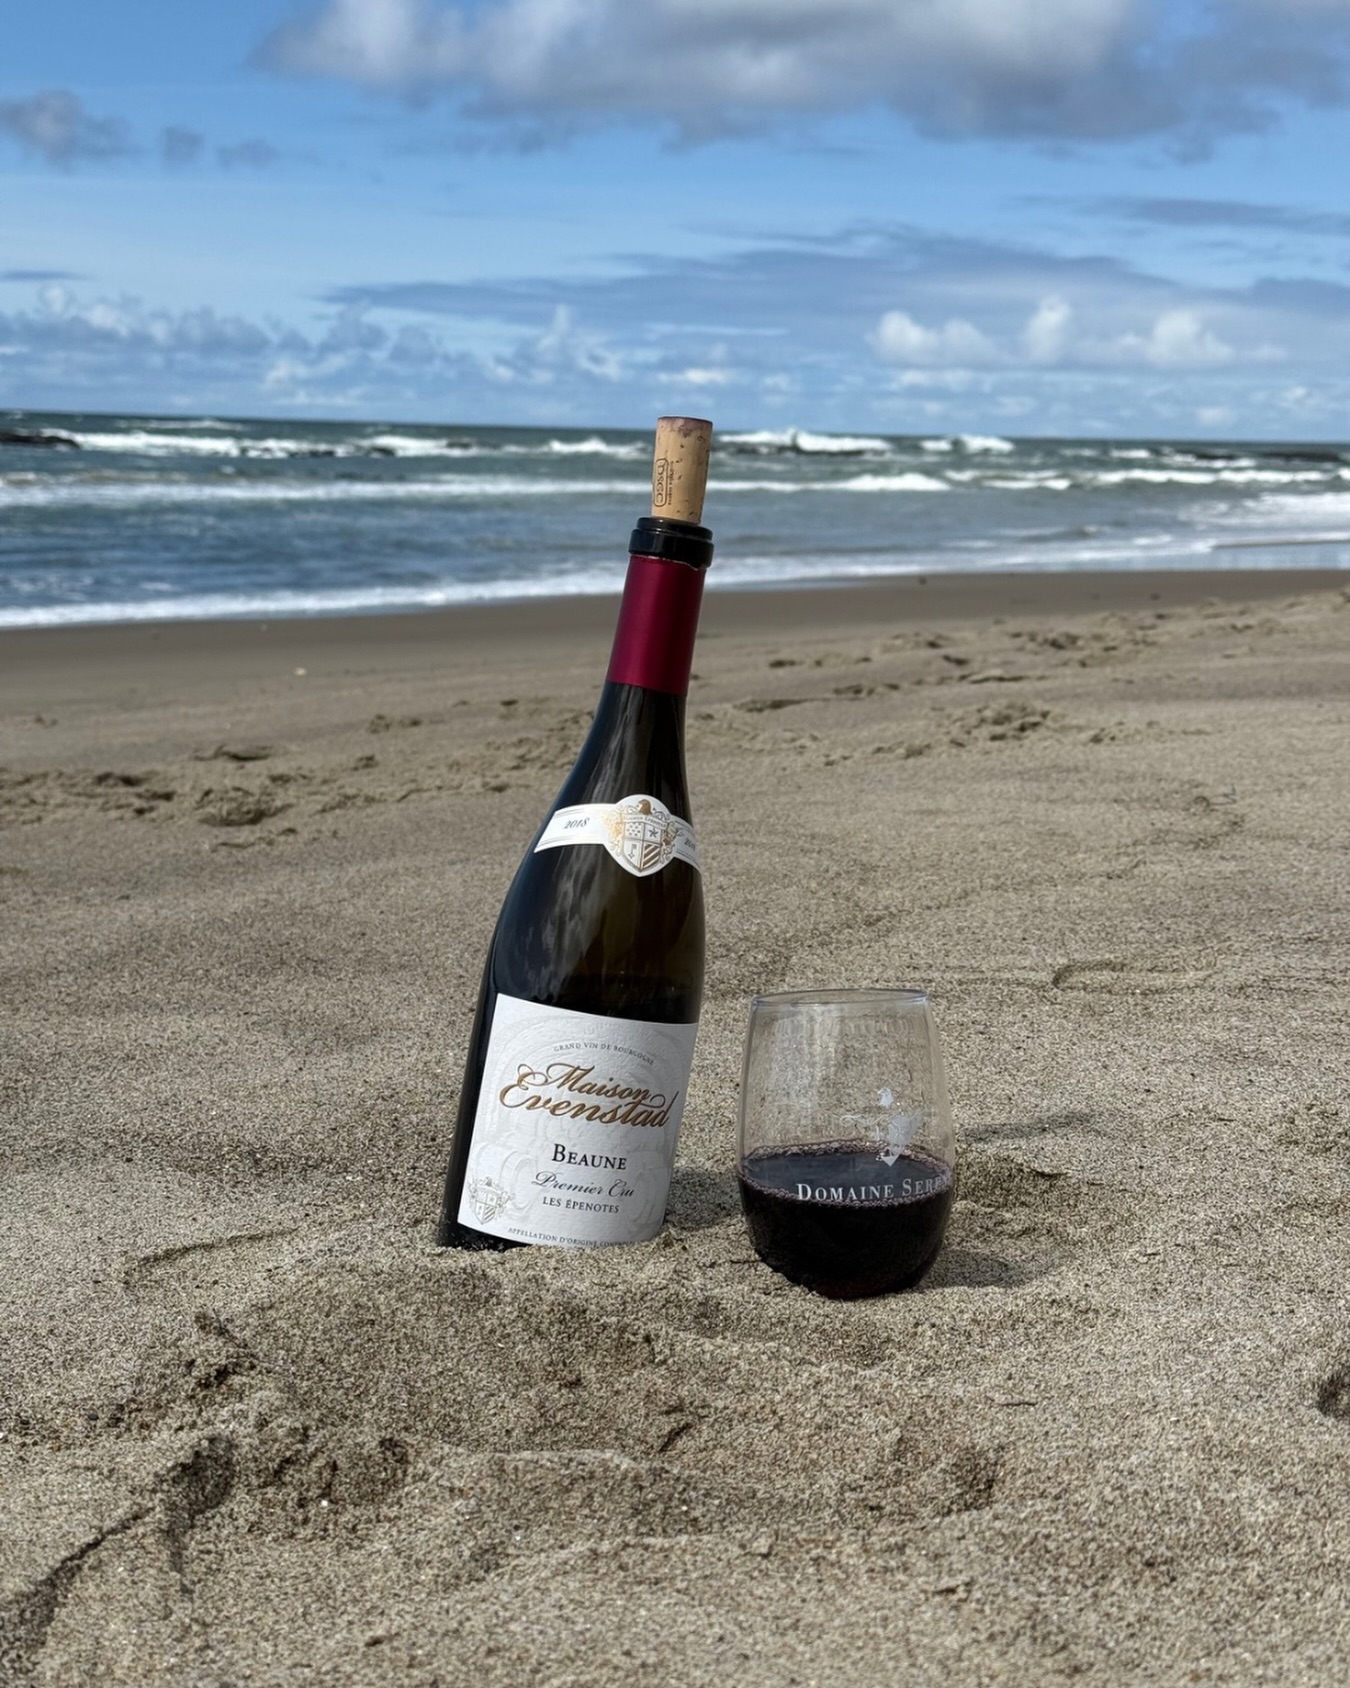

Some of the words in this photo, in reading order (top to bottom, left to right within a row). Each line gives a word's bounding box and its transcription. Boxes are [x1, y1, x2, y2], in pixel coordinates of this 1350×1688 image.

[563, 817, 590, 830] 2018
[553, 1042, 581, 1052] GRAND
[584, 1041, 599, 1049] VIN
[600, 1043, 610, 1051] DE
[613, 1045, 655, 1066] BOURGOGNE
[546, 1062, 654, 1101] Maison
[499, 1063, 680, 1128] Evenstad
[551, 1143, 628, 1171] BEAUNE
[531, 1170, 604, 1196] Premier
[608, 1178, 635, 1198] Cru
[796, 1183, 895, 1201] DOMAINE
[542, 1196, 562, 1208] LES
[565, 1199, 620, 1214] ÉPENOTES
[508, 1227, 557, 1242] APPELLATION
